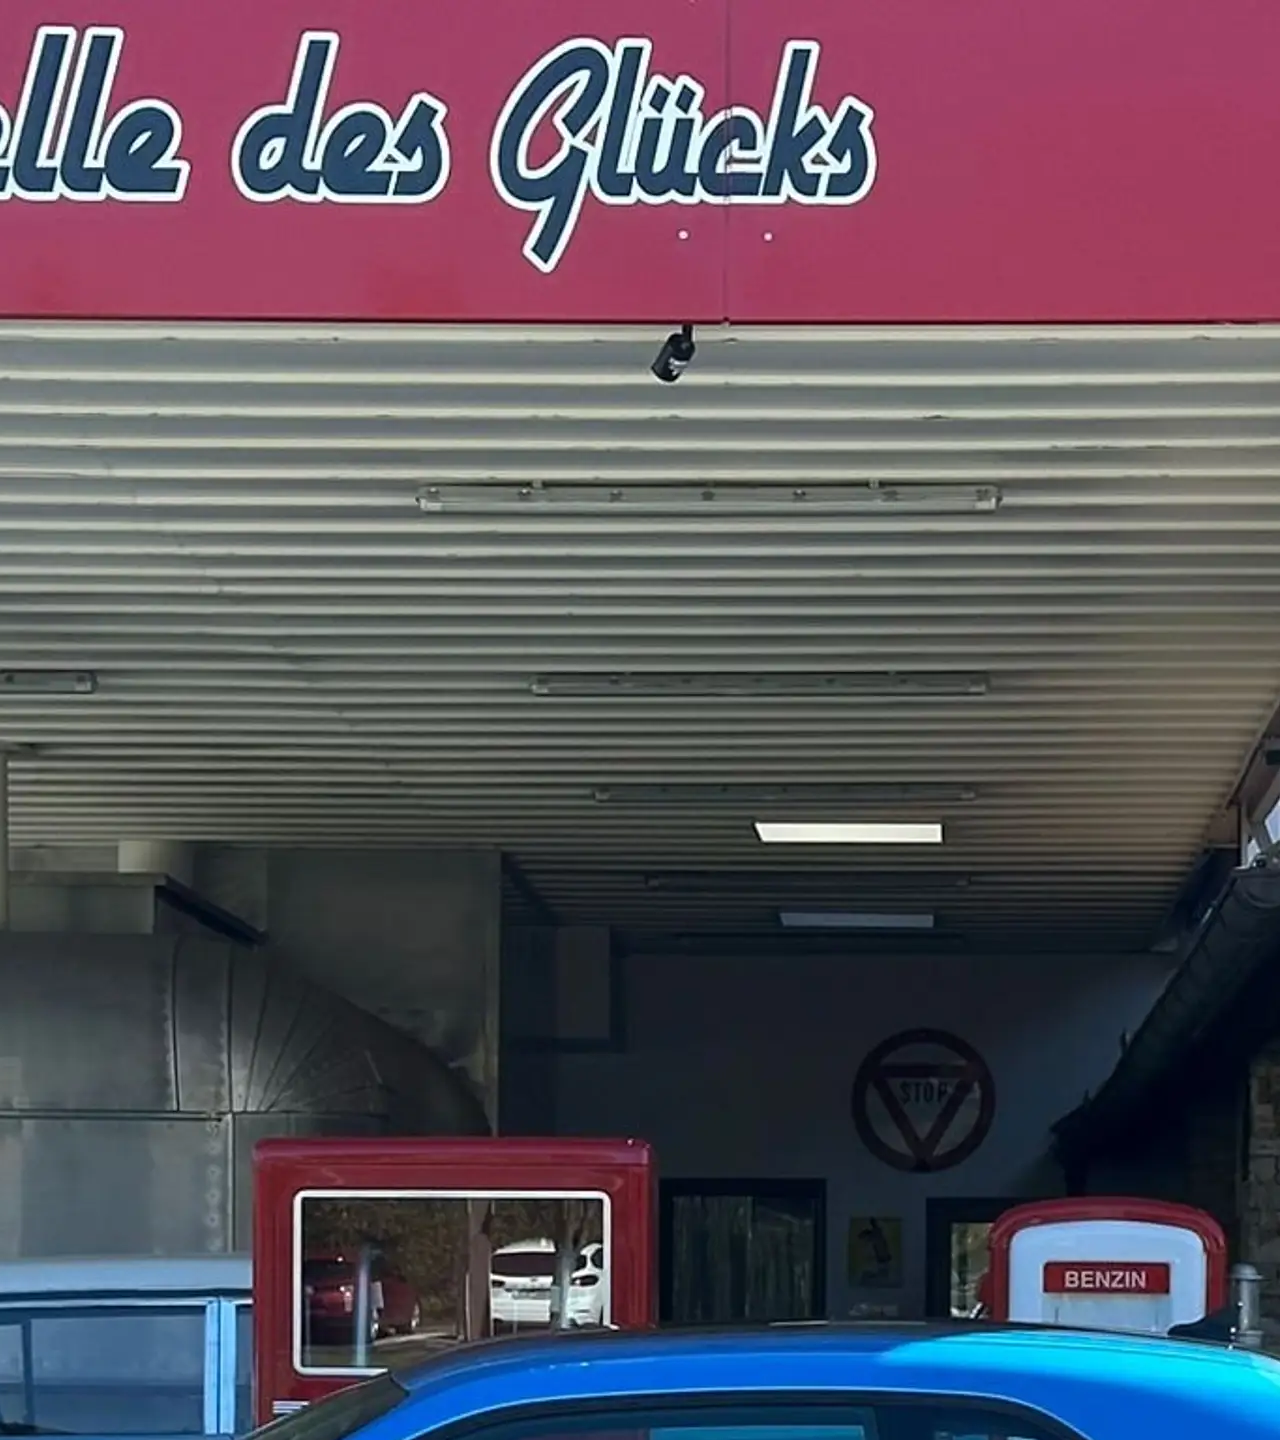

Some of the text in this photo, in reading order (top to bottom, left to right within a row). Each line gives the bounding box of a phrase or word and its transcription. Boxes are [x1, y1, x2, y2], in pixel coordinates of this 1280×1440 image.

[230, 31, 450, 204] des
[490, 37, 878, 272] Glücks
[899, 1079, 948, 1104] STOP
[1064, 1270, 1147, 1289] BENZIN
